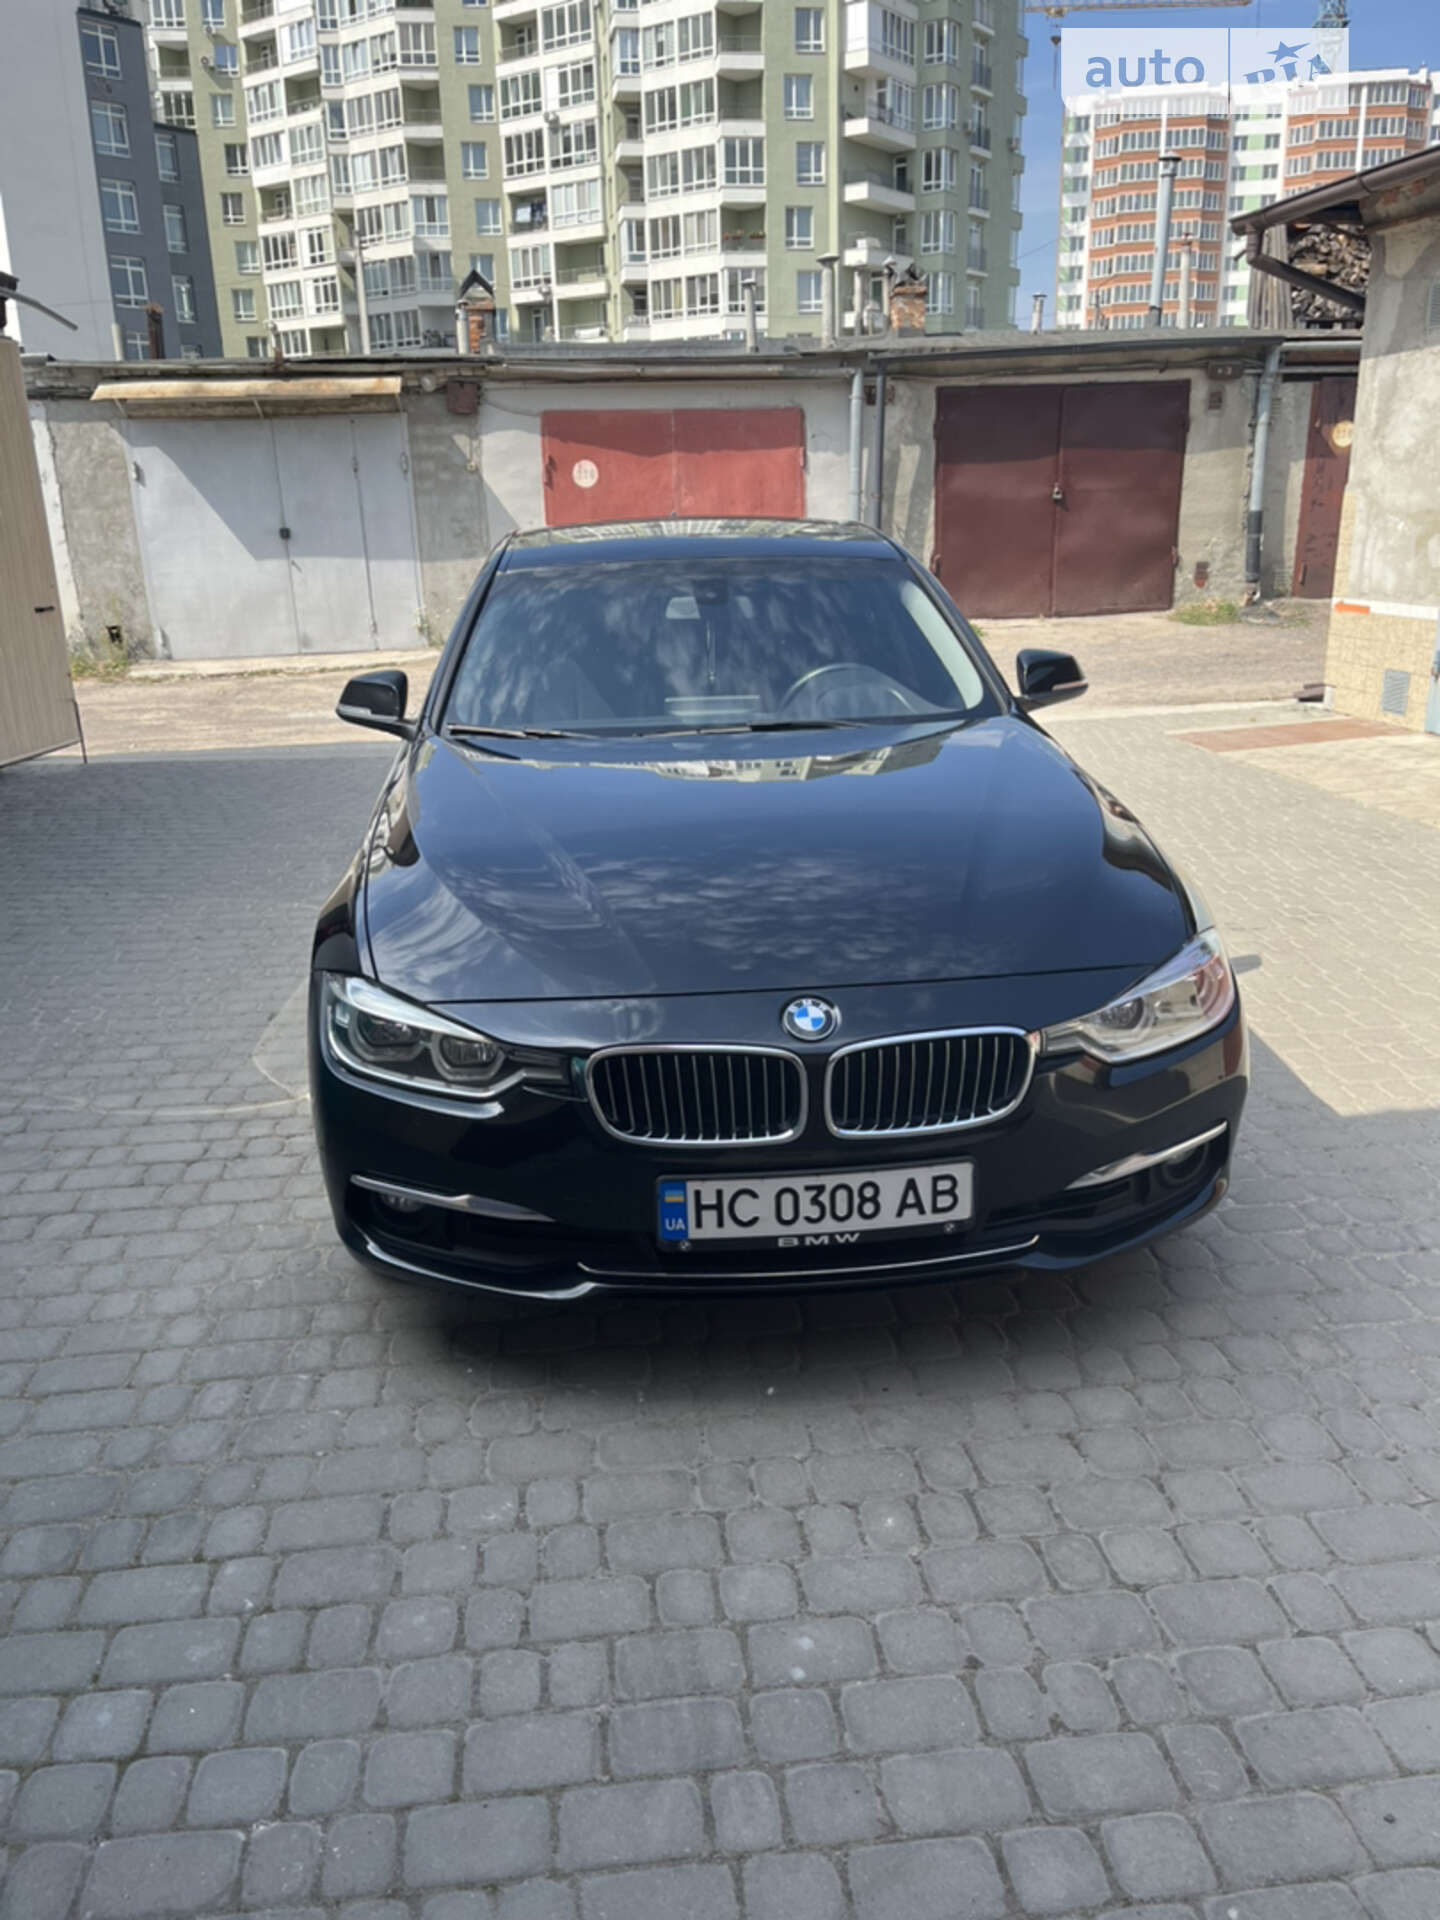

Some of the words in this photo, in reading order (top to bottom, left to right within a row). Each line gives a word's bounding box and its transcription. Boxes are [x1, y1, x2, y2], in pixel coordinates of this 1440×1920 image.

[694, 1188, 760, 1229] HC
[774, 1181, 882, 1227] 0308
[896, 1174, 959, 1218] AB
[665, 1219, 686, 1231] UA
[778, 1232, 860, 1248] BMW
